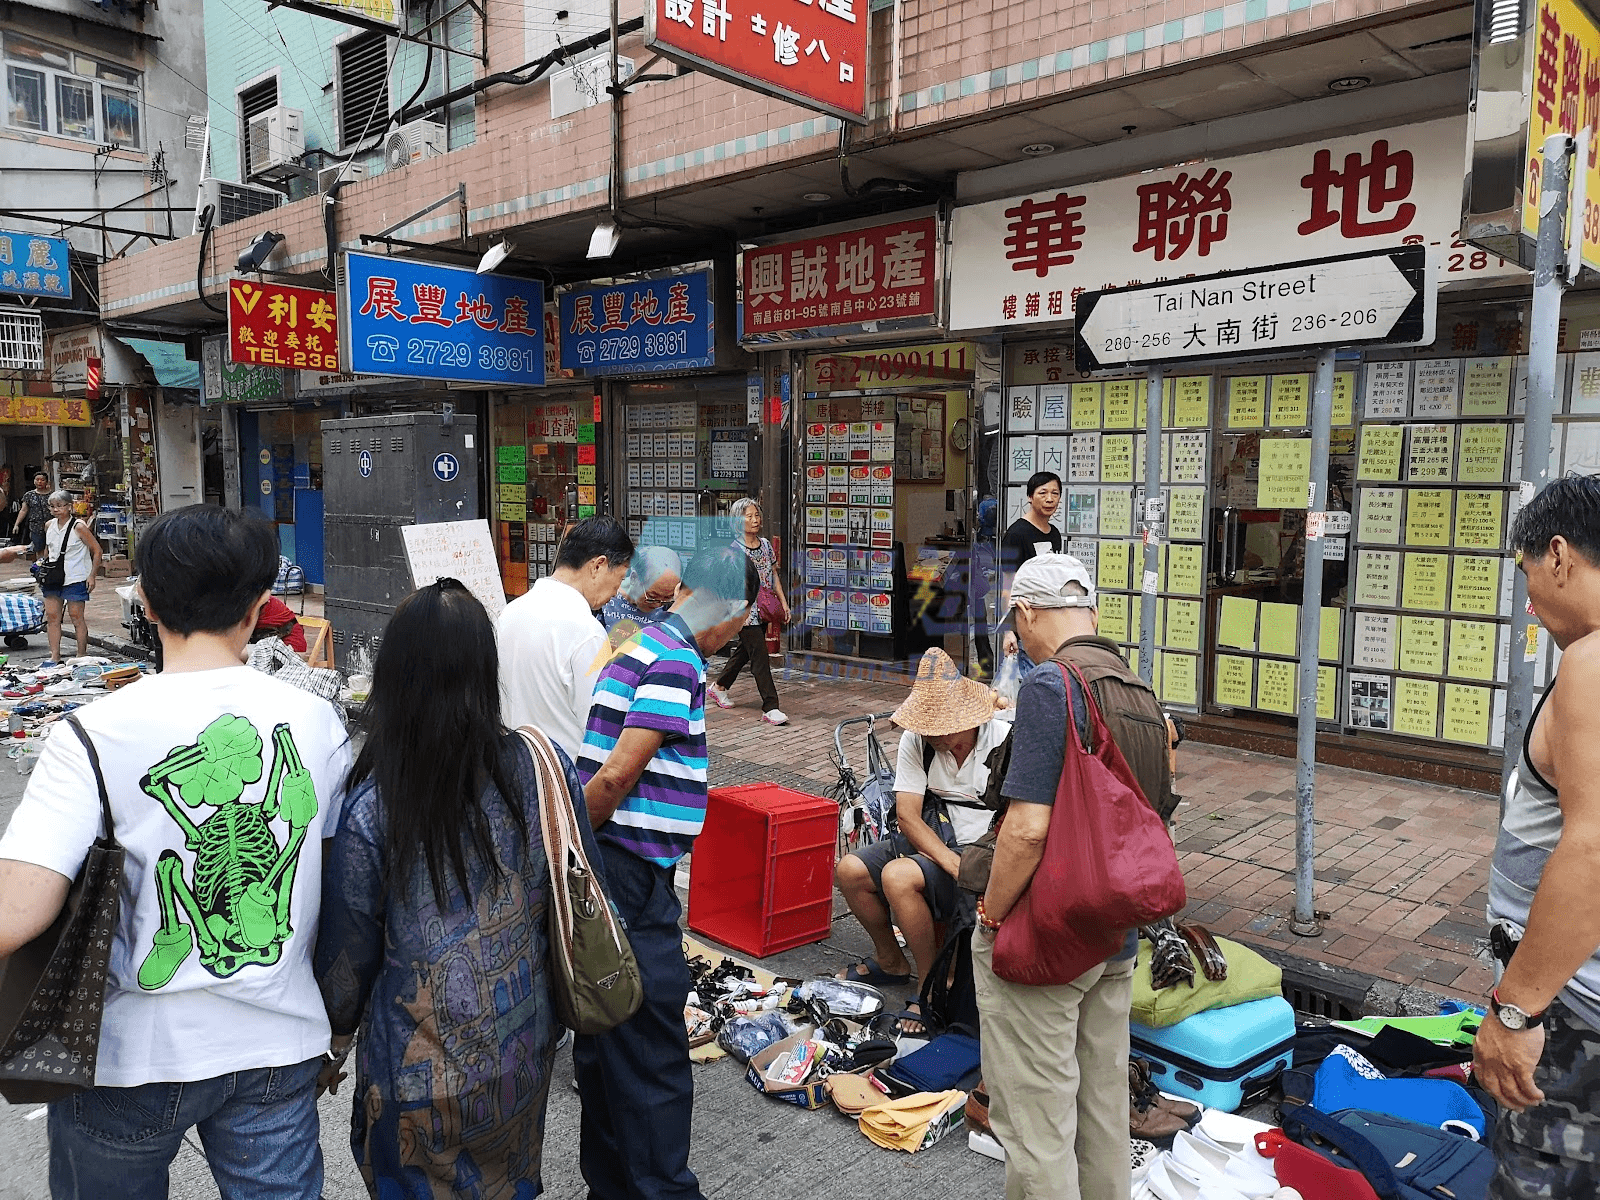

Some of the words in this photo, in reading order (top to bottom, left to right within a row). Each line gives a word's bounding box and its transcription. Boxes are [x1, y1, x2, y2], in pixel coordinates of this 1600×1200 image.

[748, 230, 926, 308] 興誠地產
[359, 275, 537, 338] 展豐地產
[569, 281, 697, 335] 展豐地產
[1153, 293, 1184, 314] Tai
[1190, 287, 1233, 310] Nan
[1242, 272, 1317, 302] Street
[599, 335, 641, 362] 2729
[645, 329, 688, 357] 3881
[1104, 331, 1172, 354] 280-256
[1183, 311, 1279, 350] 大南街
[1291, 308, 1378, 333] 236-206
[406, 338, 473, 368] 2729
[477, 344, 534, 373] 3881
[1413, 436, 1448, 445] 高層洋樓
